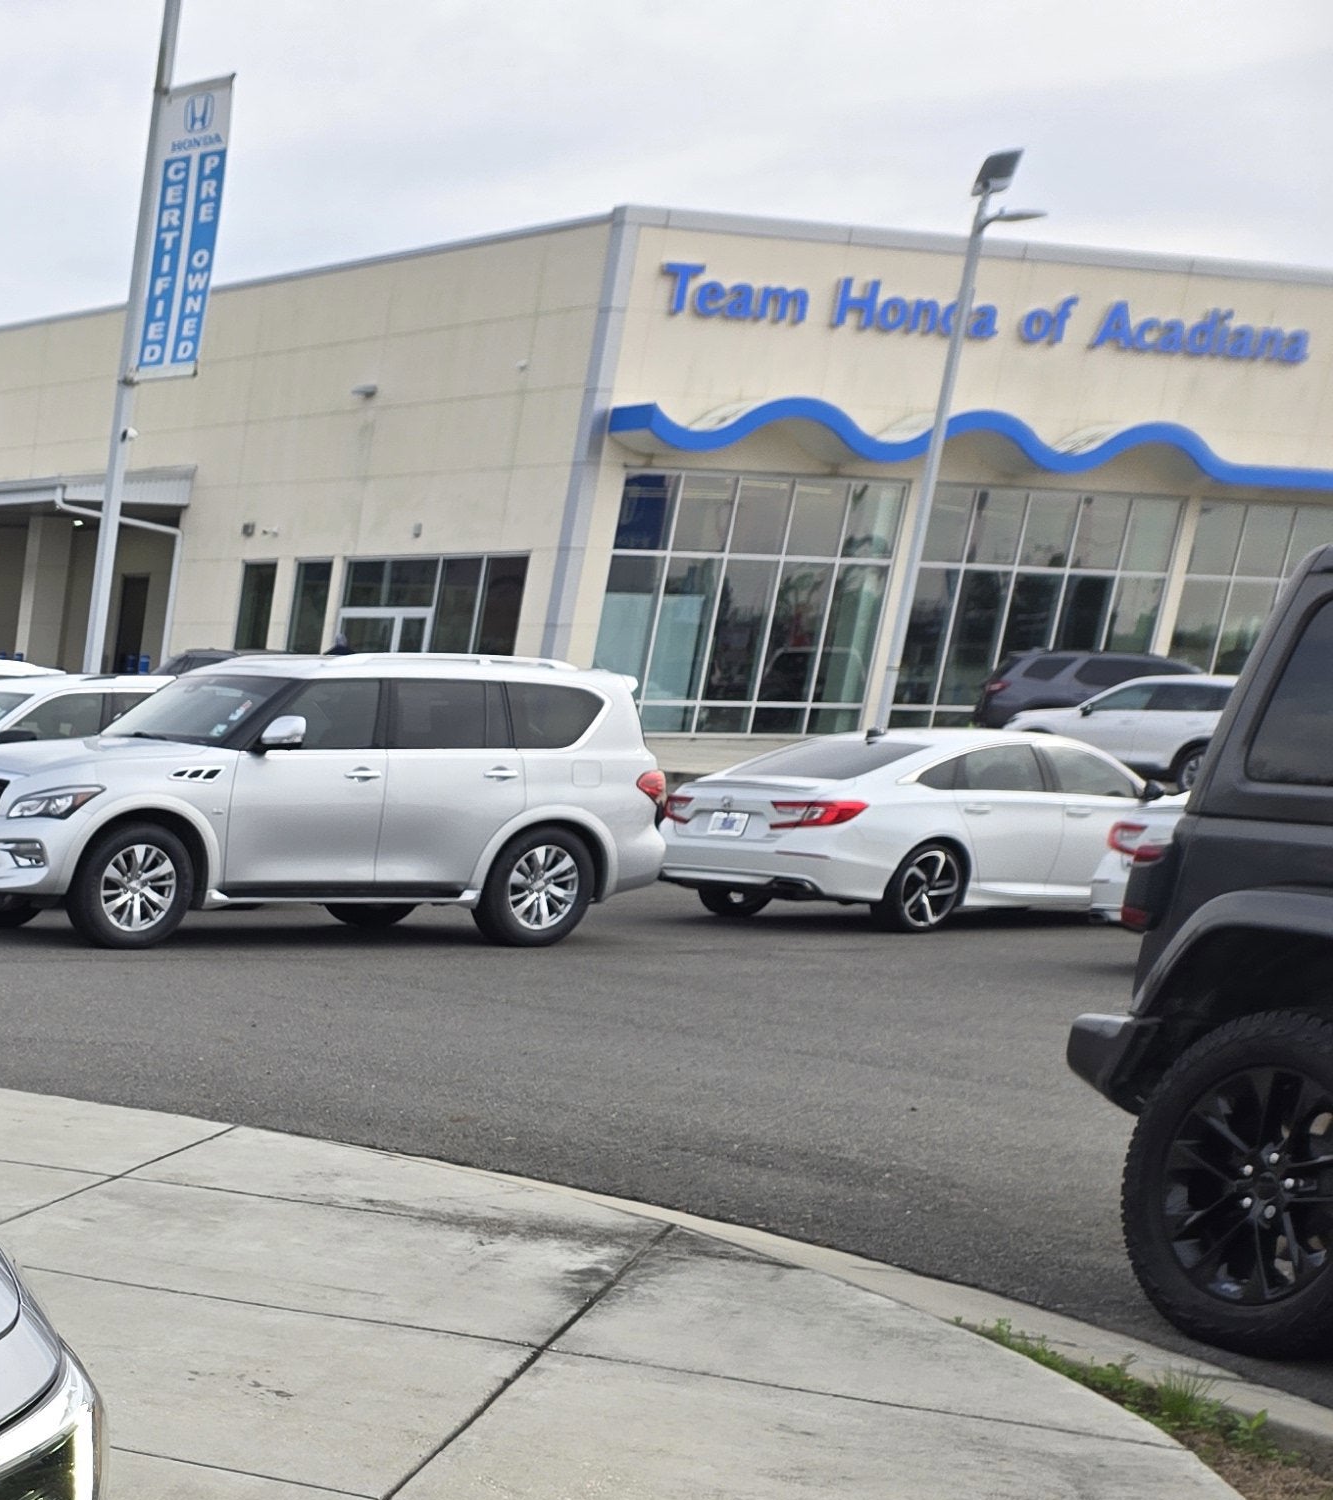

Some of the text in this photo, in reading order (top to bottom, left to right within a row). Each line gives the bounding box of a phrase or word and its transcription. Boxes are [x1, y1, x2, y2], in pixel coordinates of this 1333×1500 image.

[141, 160, 187, 363] CERTIFIED
[176, 154, 220, 360] PRE OWNED
[662, 261, 810, 325] Team
[1020, 295, 1080, 346] of
[1090, 300, 1311, 364] Acadiana
